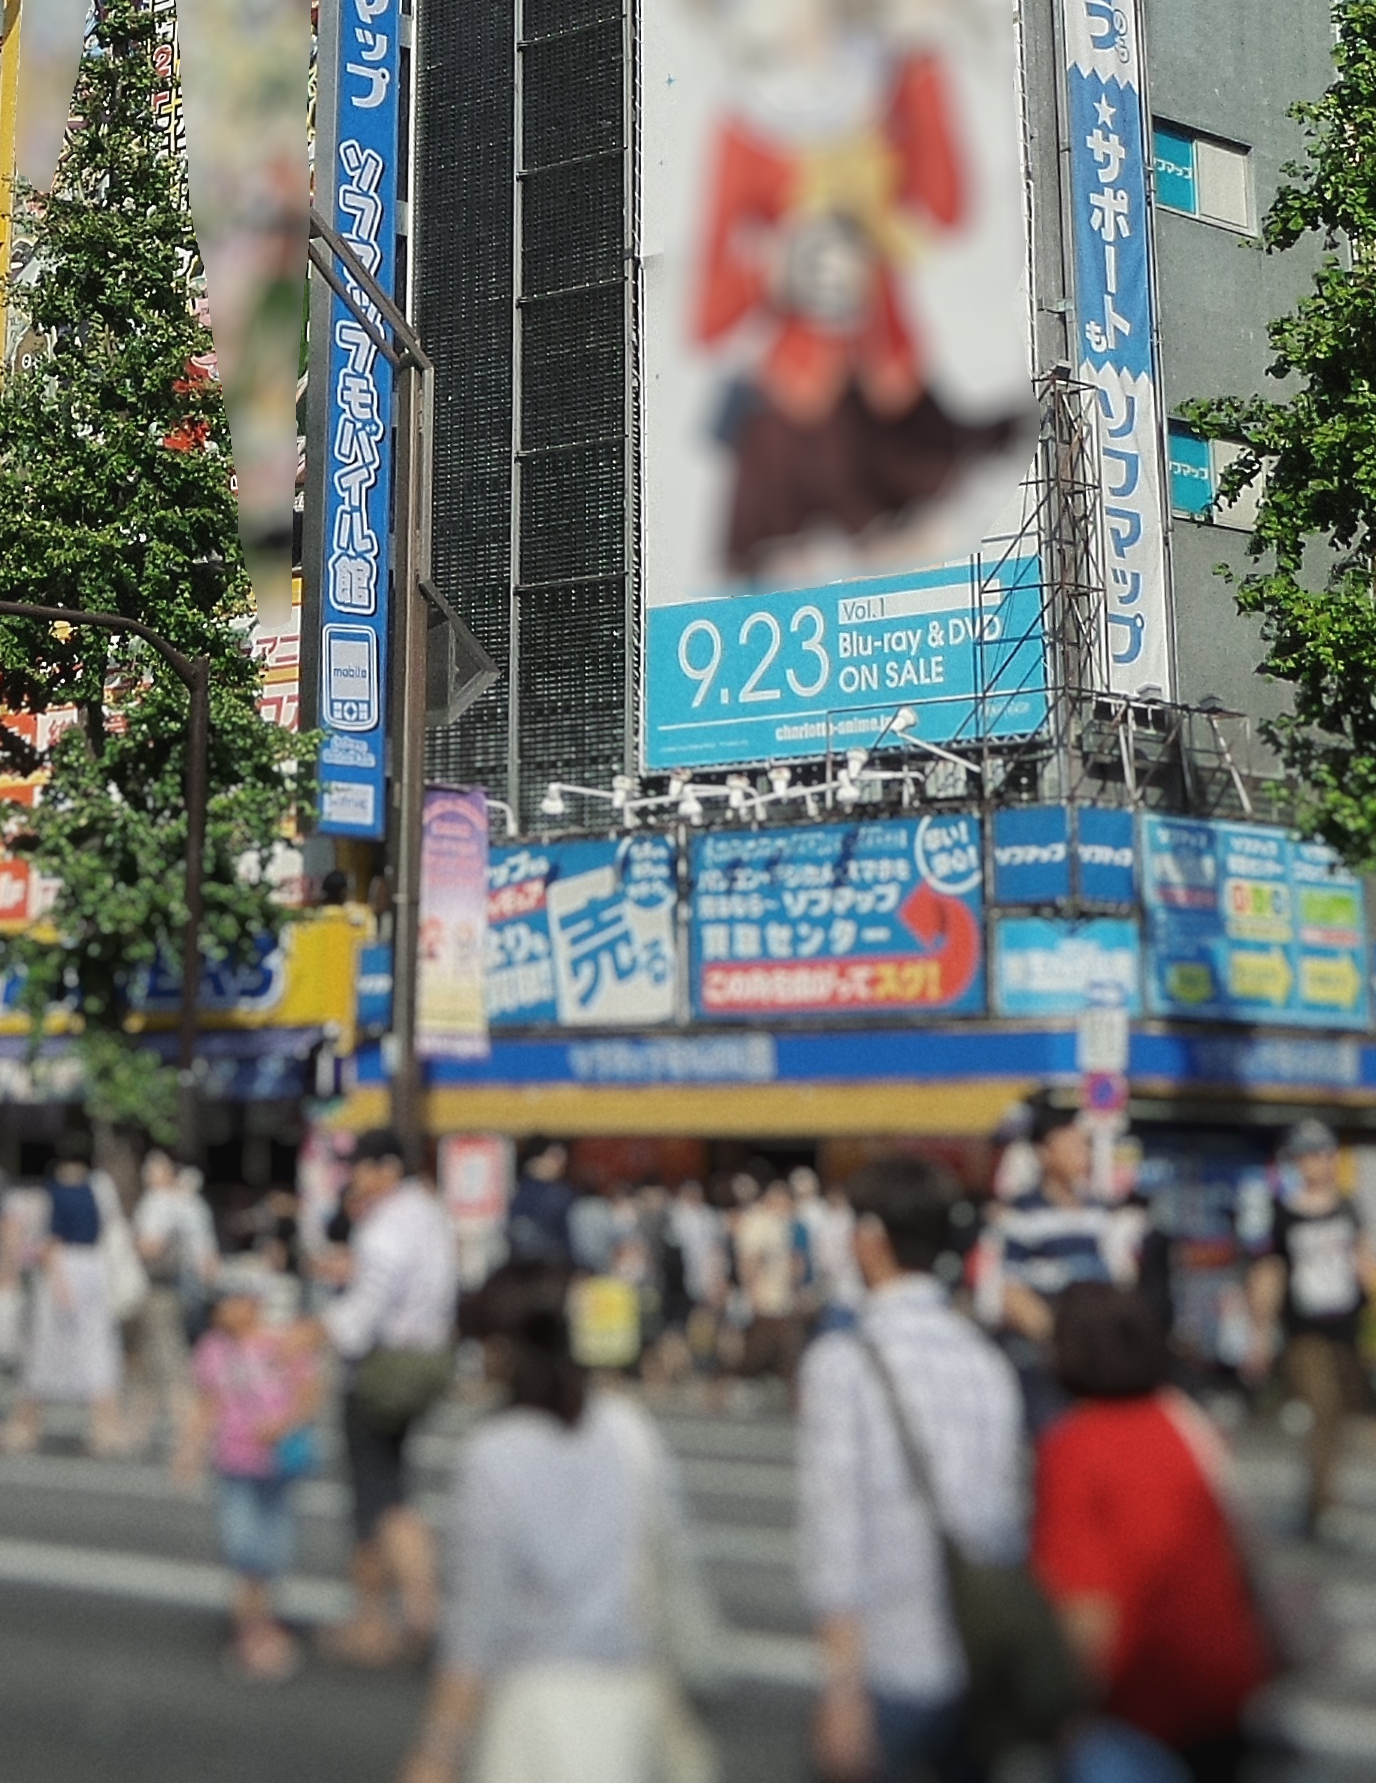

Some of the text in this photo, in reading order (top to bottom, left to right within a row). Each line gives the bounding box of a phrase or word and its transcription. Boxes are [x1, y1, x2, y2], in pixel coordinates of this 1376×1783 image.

[1085, 127, 1131, 354] サポートも
[1095, 384, 1146, 666] ソフマップ
[842, 598, 887, 622] Vol.1
[677, 604, 831, 709] 9.23
[838, 615, 1001, 664] Blu-ray & DVD
[333, 668, 367, 679] mobile
[838, 656, 945, 693] ON SALE
